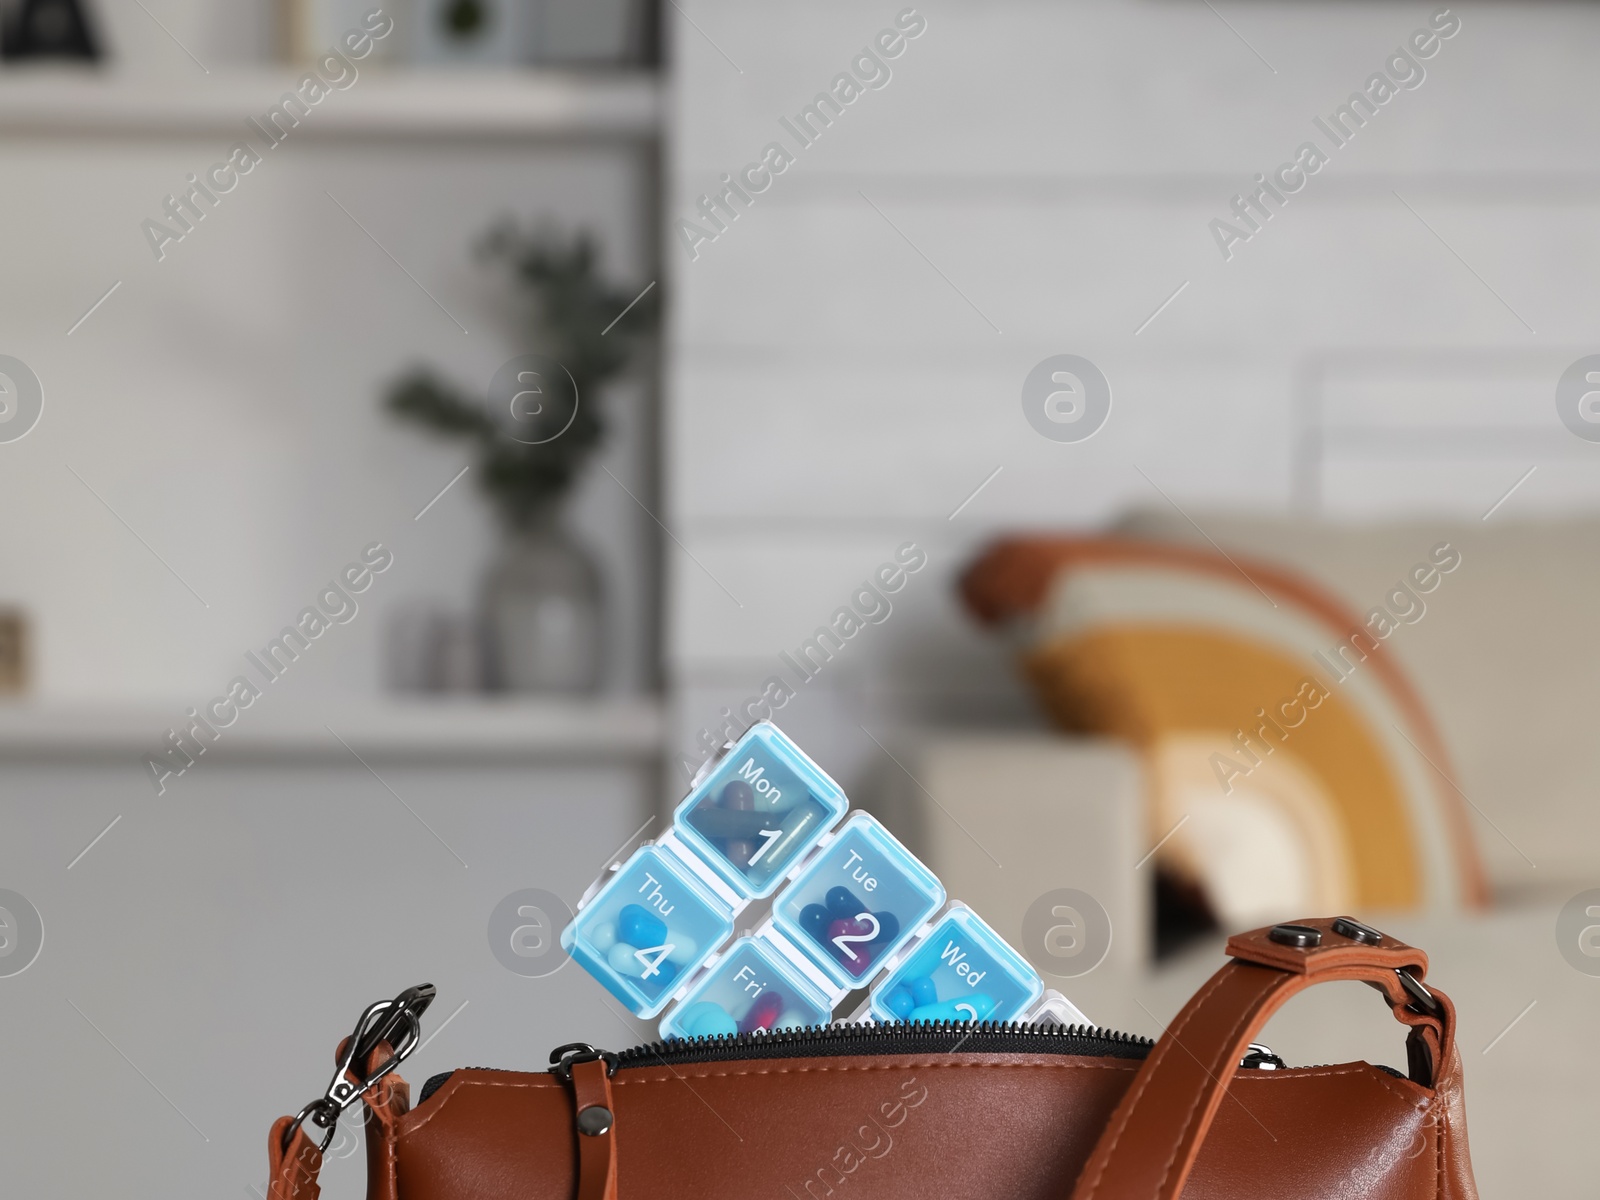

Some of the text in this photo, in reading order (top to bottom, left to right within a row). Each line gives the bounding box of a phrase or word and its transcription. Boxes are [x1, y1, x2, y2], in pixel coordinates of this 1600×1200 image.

[738, 757, 781, 804] Mon
[747, 829, 783, 867] 1
[842, 849, 878, 892] Tue
[638, 872, 675, 917] Thu
[831, 912, 880, 961] 2
[633, 943, 676, 980] 4
[733, 965, 767, 998] Fri
[941, 940, 986, 988] Wed
